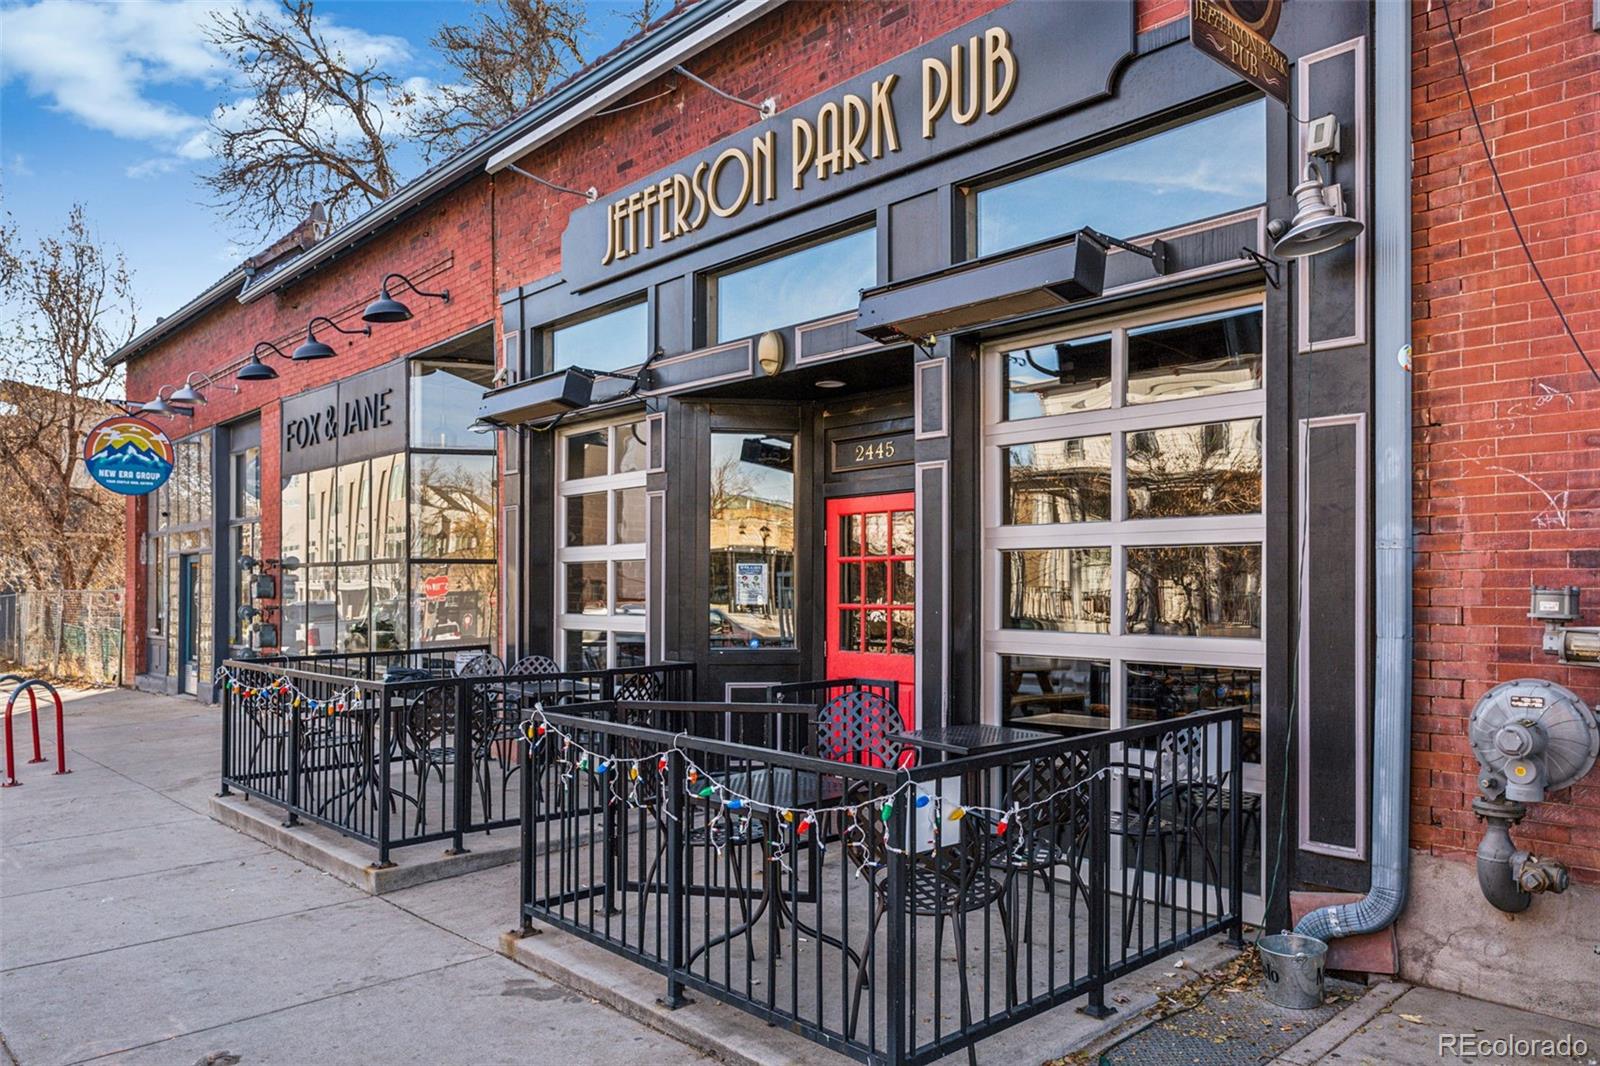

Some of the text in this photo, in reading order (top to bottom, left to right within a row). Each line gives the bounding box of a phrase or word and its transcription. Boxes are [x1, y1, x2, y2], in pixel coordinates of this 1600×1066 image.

[1231, 39, 1259, 78] PUB
[1261, 42, 1288, 77] PARK
[601, 26, 1018, 265] JEFFERSON PARK PUB
[286, 387, 394, 452] FOX & JANE
[855, 440, 896, 462] 2445
[98, 468, 161, 481] NEW ERA GROUP
